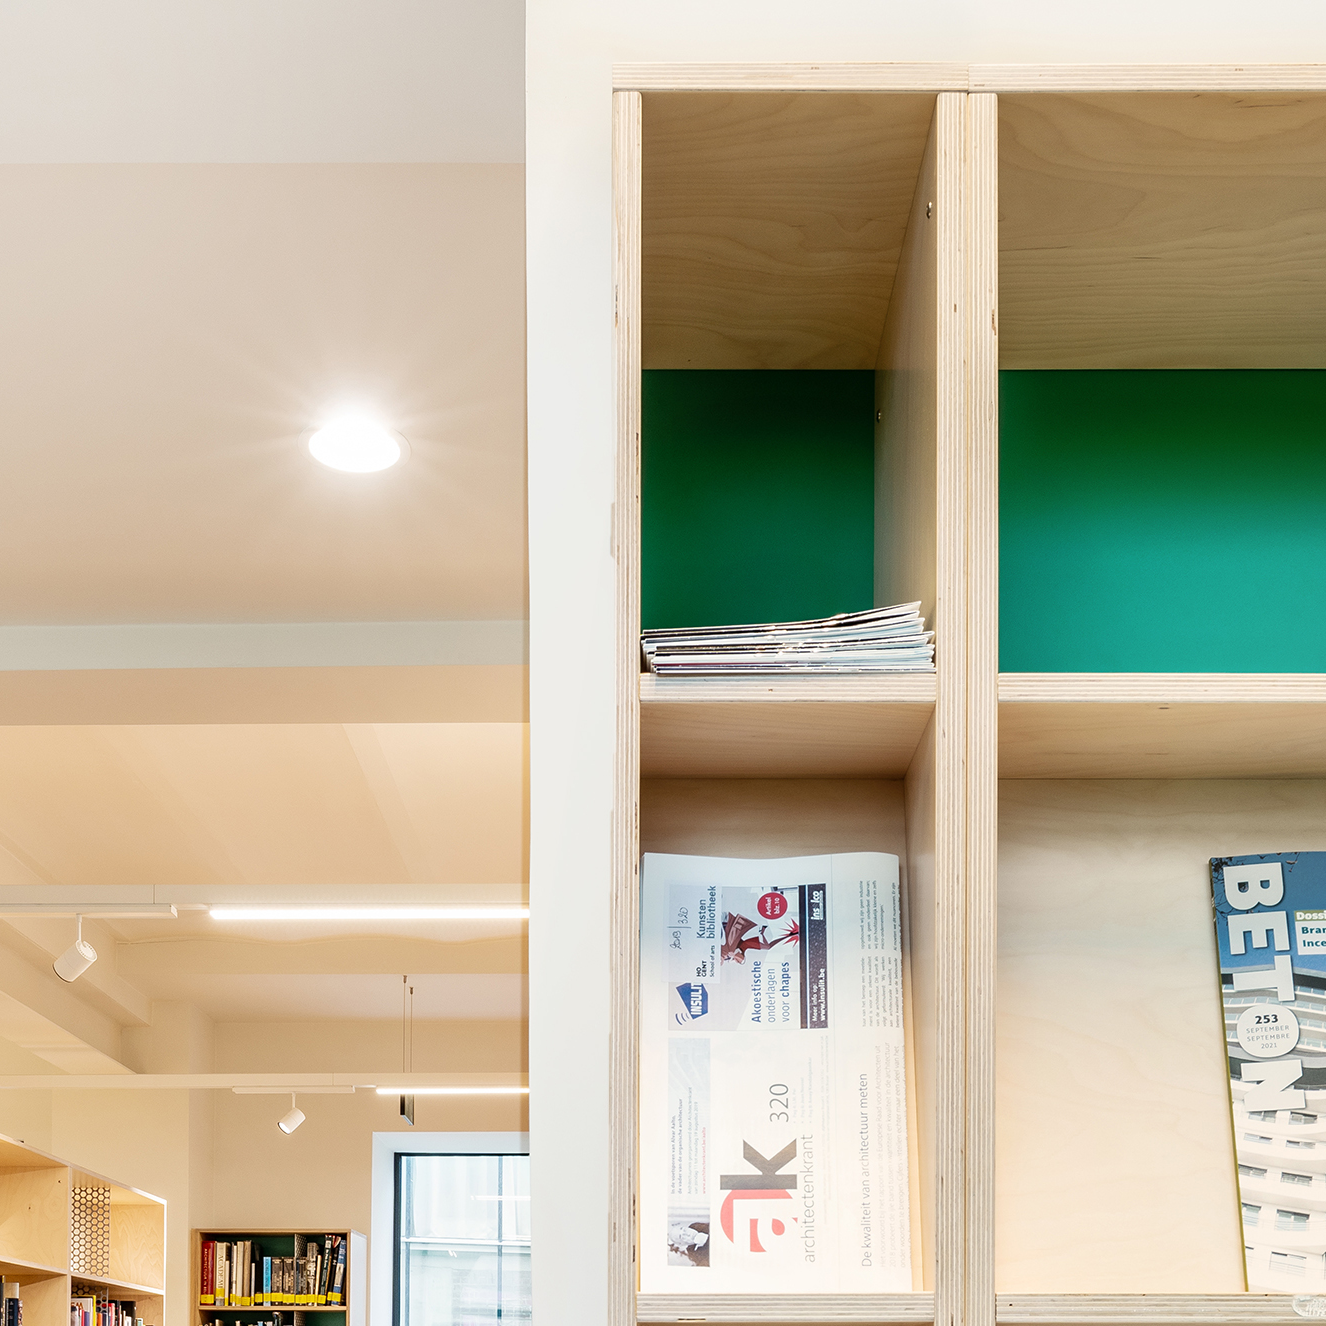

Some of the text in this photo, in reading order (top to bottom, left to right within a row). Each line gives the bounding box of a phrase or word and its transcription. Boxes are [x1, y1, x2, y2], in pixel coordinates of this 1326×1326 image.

[697, 899, 706, 938] Kunsten
[707, 886, 716, 938] bibliotheek
[696, 967, 702, 977] HO
[751, 961, 761, 1022] Akoestische
[779, 962, 791, 1022] voor chapes
[766, 968, 777, 1022] onderlagen
[1246, 1025, 1290, 1033] SEPTEMBER
[1246, 1033, 1290, 1041] SEPTEMBRE
[1254, 1014, 1279, 1024] 253
[769, 1083, 789, 1122] 320
[859, 1073, 872, 1267] De kwaliteit van architectuur meten
[800, 1134, 815, 1262] architectenkrant
